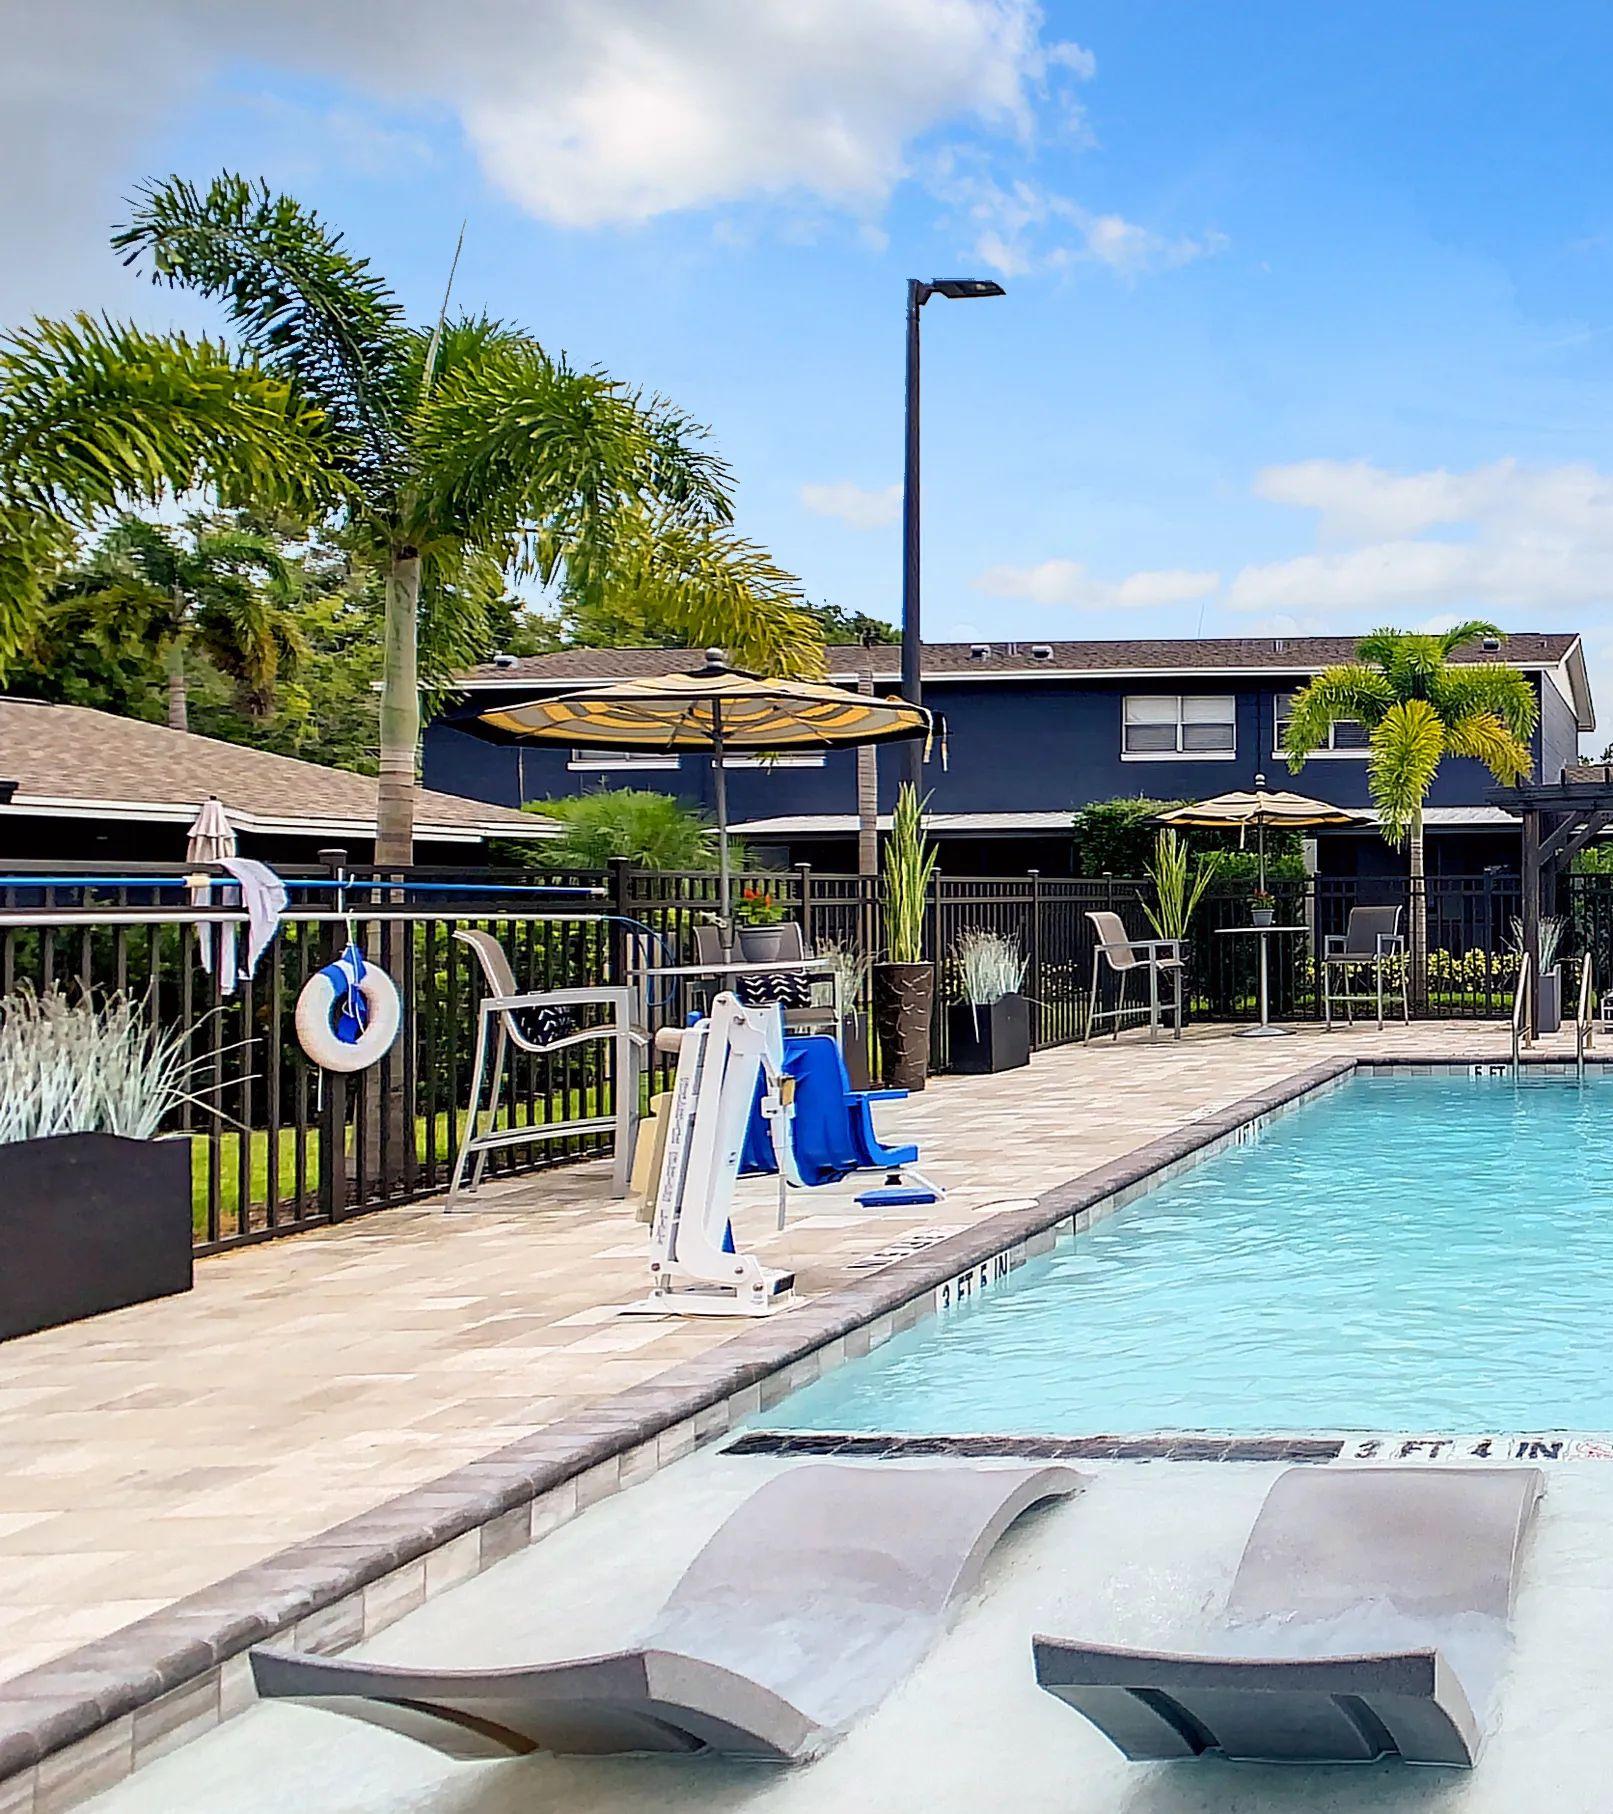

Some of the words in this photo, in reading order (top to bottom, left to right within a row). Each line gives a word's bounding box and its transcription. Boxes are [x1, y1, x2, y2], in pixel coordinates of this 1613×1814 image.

[1489, 1065, 1505, 1077] FT
[942, 1284, 950, 1309] 3
[957, 1271, 974, 1302] FT
[994, 1252, 1008, 1281] IN
[1355, 1439, 1382, 1458] 3
[1400, 1439, 1454, 1459] FT
[1469, 1439, 1493, 1459] 4
[1514, 1440, 1564, 1459] IN
